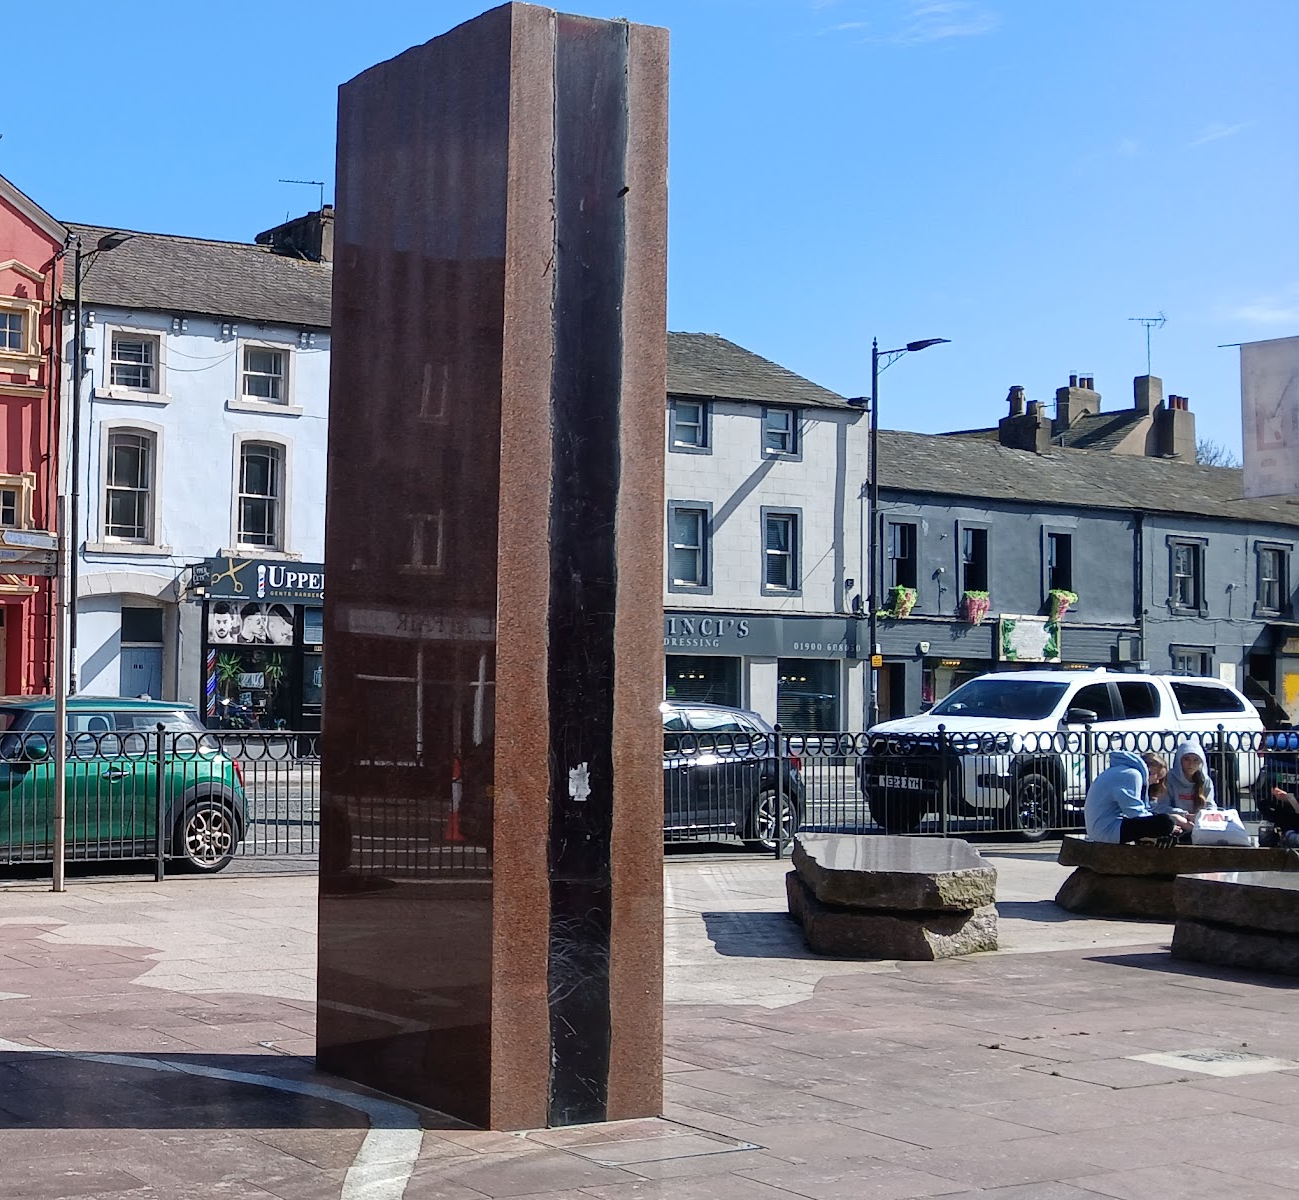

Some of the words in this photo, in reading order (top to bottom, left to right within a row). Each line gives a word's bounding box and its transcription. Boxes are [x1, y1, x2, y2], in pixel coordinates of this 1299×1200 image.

[669, 617, 749, 637] INCI'S
[663, 637, 720, 648] DRESSING
[793, 642, 822, 651] 01900
